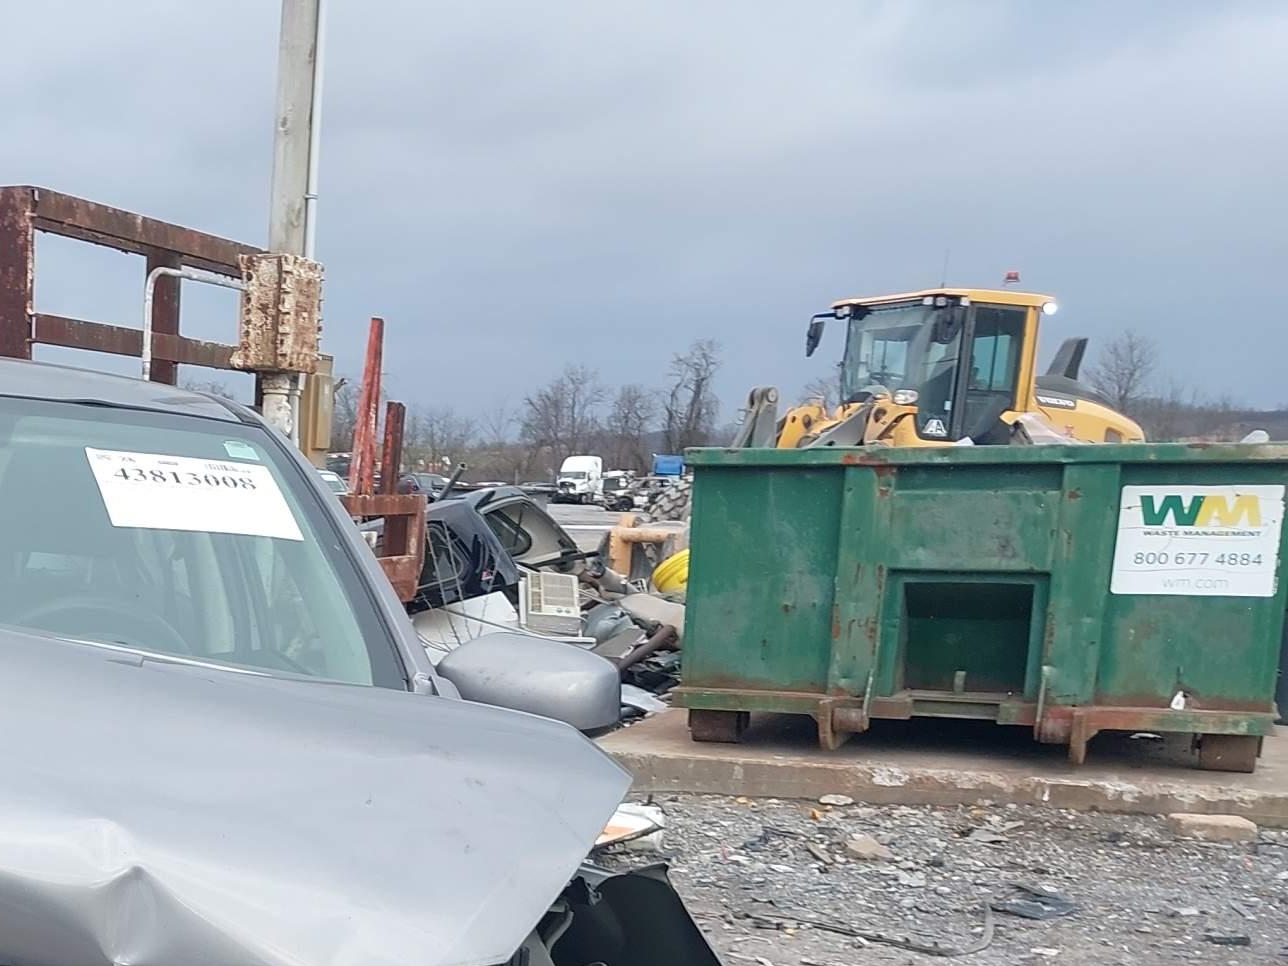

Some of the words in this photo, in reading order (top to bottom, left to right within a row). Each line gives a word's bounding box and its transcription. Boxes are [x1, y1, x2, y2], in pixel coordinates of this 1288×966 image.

[114, 467, 257, 491] 43813008
[1141, 496, 1260, 526] WM
[1133, 552, 1169, 565] 800
[1175, 552, 1209, 565] 677
[1215, 553, 1263, 566] 4884
